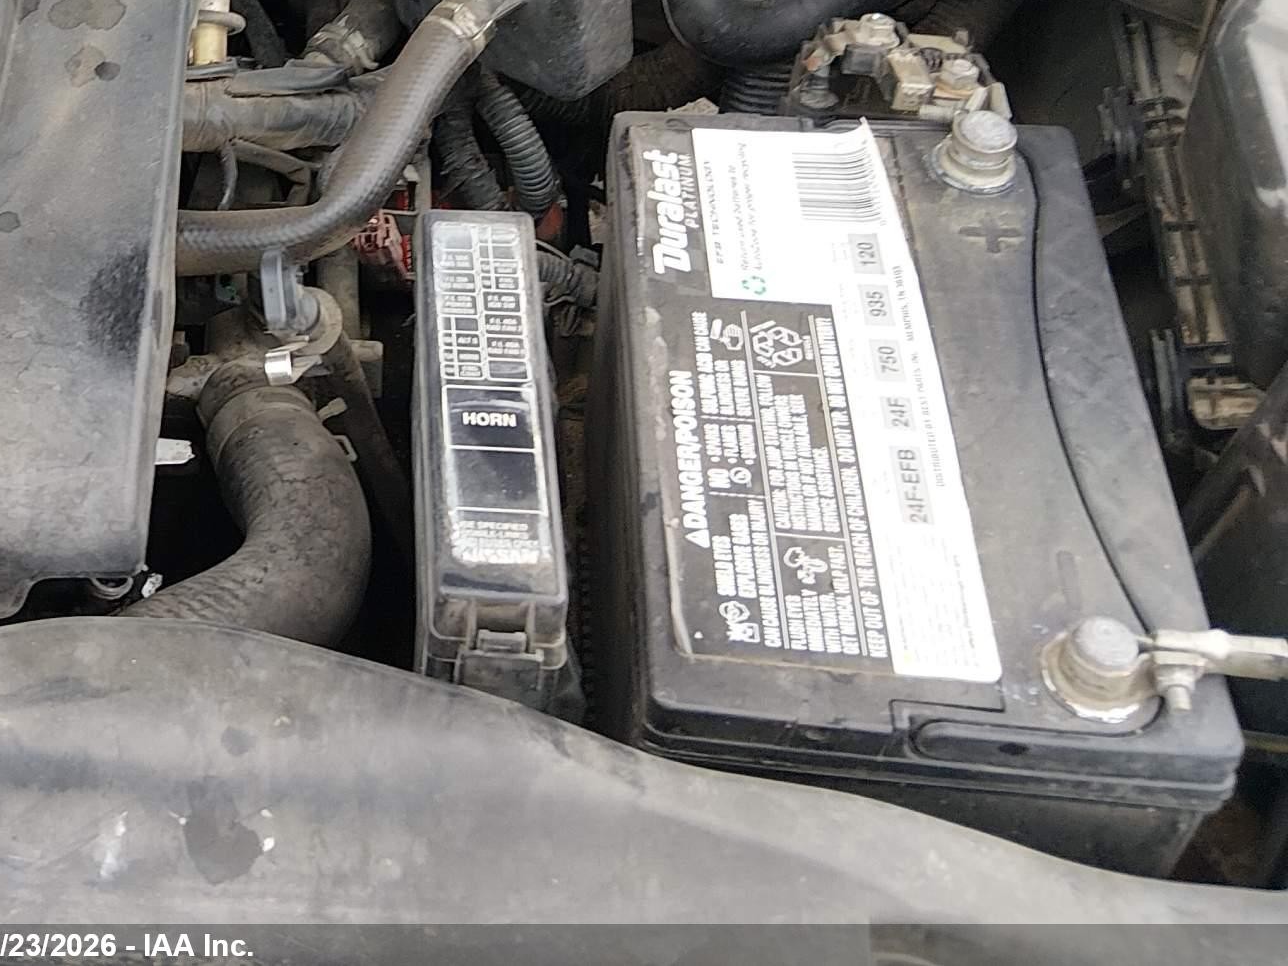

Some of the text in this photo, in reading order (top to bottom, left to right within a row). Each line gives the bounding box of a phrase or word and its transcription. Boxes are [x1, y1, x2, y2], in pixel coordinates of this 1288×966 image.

[677, 154, 700, 228] PLATINUM
[641, 149, 692, 273] Duralast
[854, 241, 877, 266] 120
[864, 290, 888, 317] 935
[691, 311, 709, 335] CAUSE
[693, 336, 711, 351] CAN
[713, 359, 730, 371] OR
[820, 355, 841, 376] OPEN
[875, 345, 901, 374] 750
[732, 386, 752, 416] SEVERE
[885, 396, 910, 427] 24F
[462, 411, 517, 427] HORN
[667, 370, 711, 528] DANGER/POISON
[702, 423, 722, 455] SPARKS
[720, 424, 739, 456] FLAMES
[832, 427, 853, 446] NOT
[764, 445, 784, 468] JUMP
[783, 460, 799, 470] IN
[798, 457, 815, 473] NOT
[835, 447, 855, 461] DO
[922, 432, 946, 487] DISTRIBUTED
[706, 467, 731, 488] NO
[767, 469, 786, 486] FOR
[800, 474, 816, 483] IF
[802, 484, 818, 496] OR
[894, 448, 930, 524] 24F-EFB
[803, 497, 824, 531] MANUAL
[819, 497, 841, 532] SERVICE
[847, 517, 868, 531] OF
[711, 535, 732, 560] EYES
[728, 513, 757, 597] EXPLOSIVE GASES
[849, 531, 874, 566] REACH
[747, 499, 782, 647] CAN CAUSE BLINDNESS OR INJURY
[830, 569, 851, 593] HELP
[855, 567, 877, 586] THE
[858, 590, 880, 605] OF
[784, 594, 808, 650] FLUSH EYES
[834, 593, 858, 635] MEDICAL
[861, 606, 884, 629] OUT
[822, 627, 843, 653] WITH
[840, 635, 861, 654] GET
[865, 629, 889, 657] KEEP
